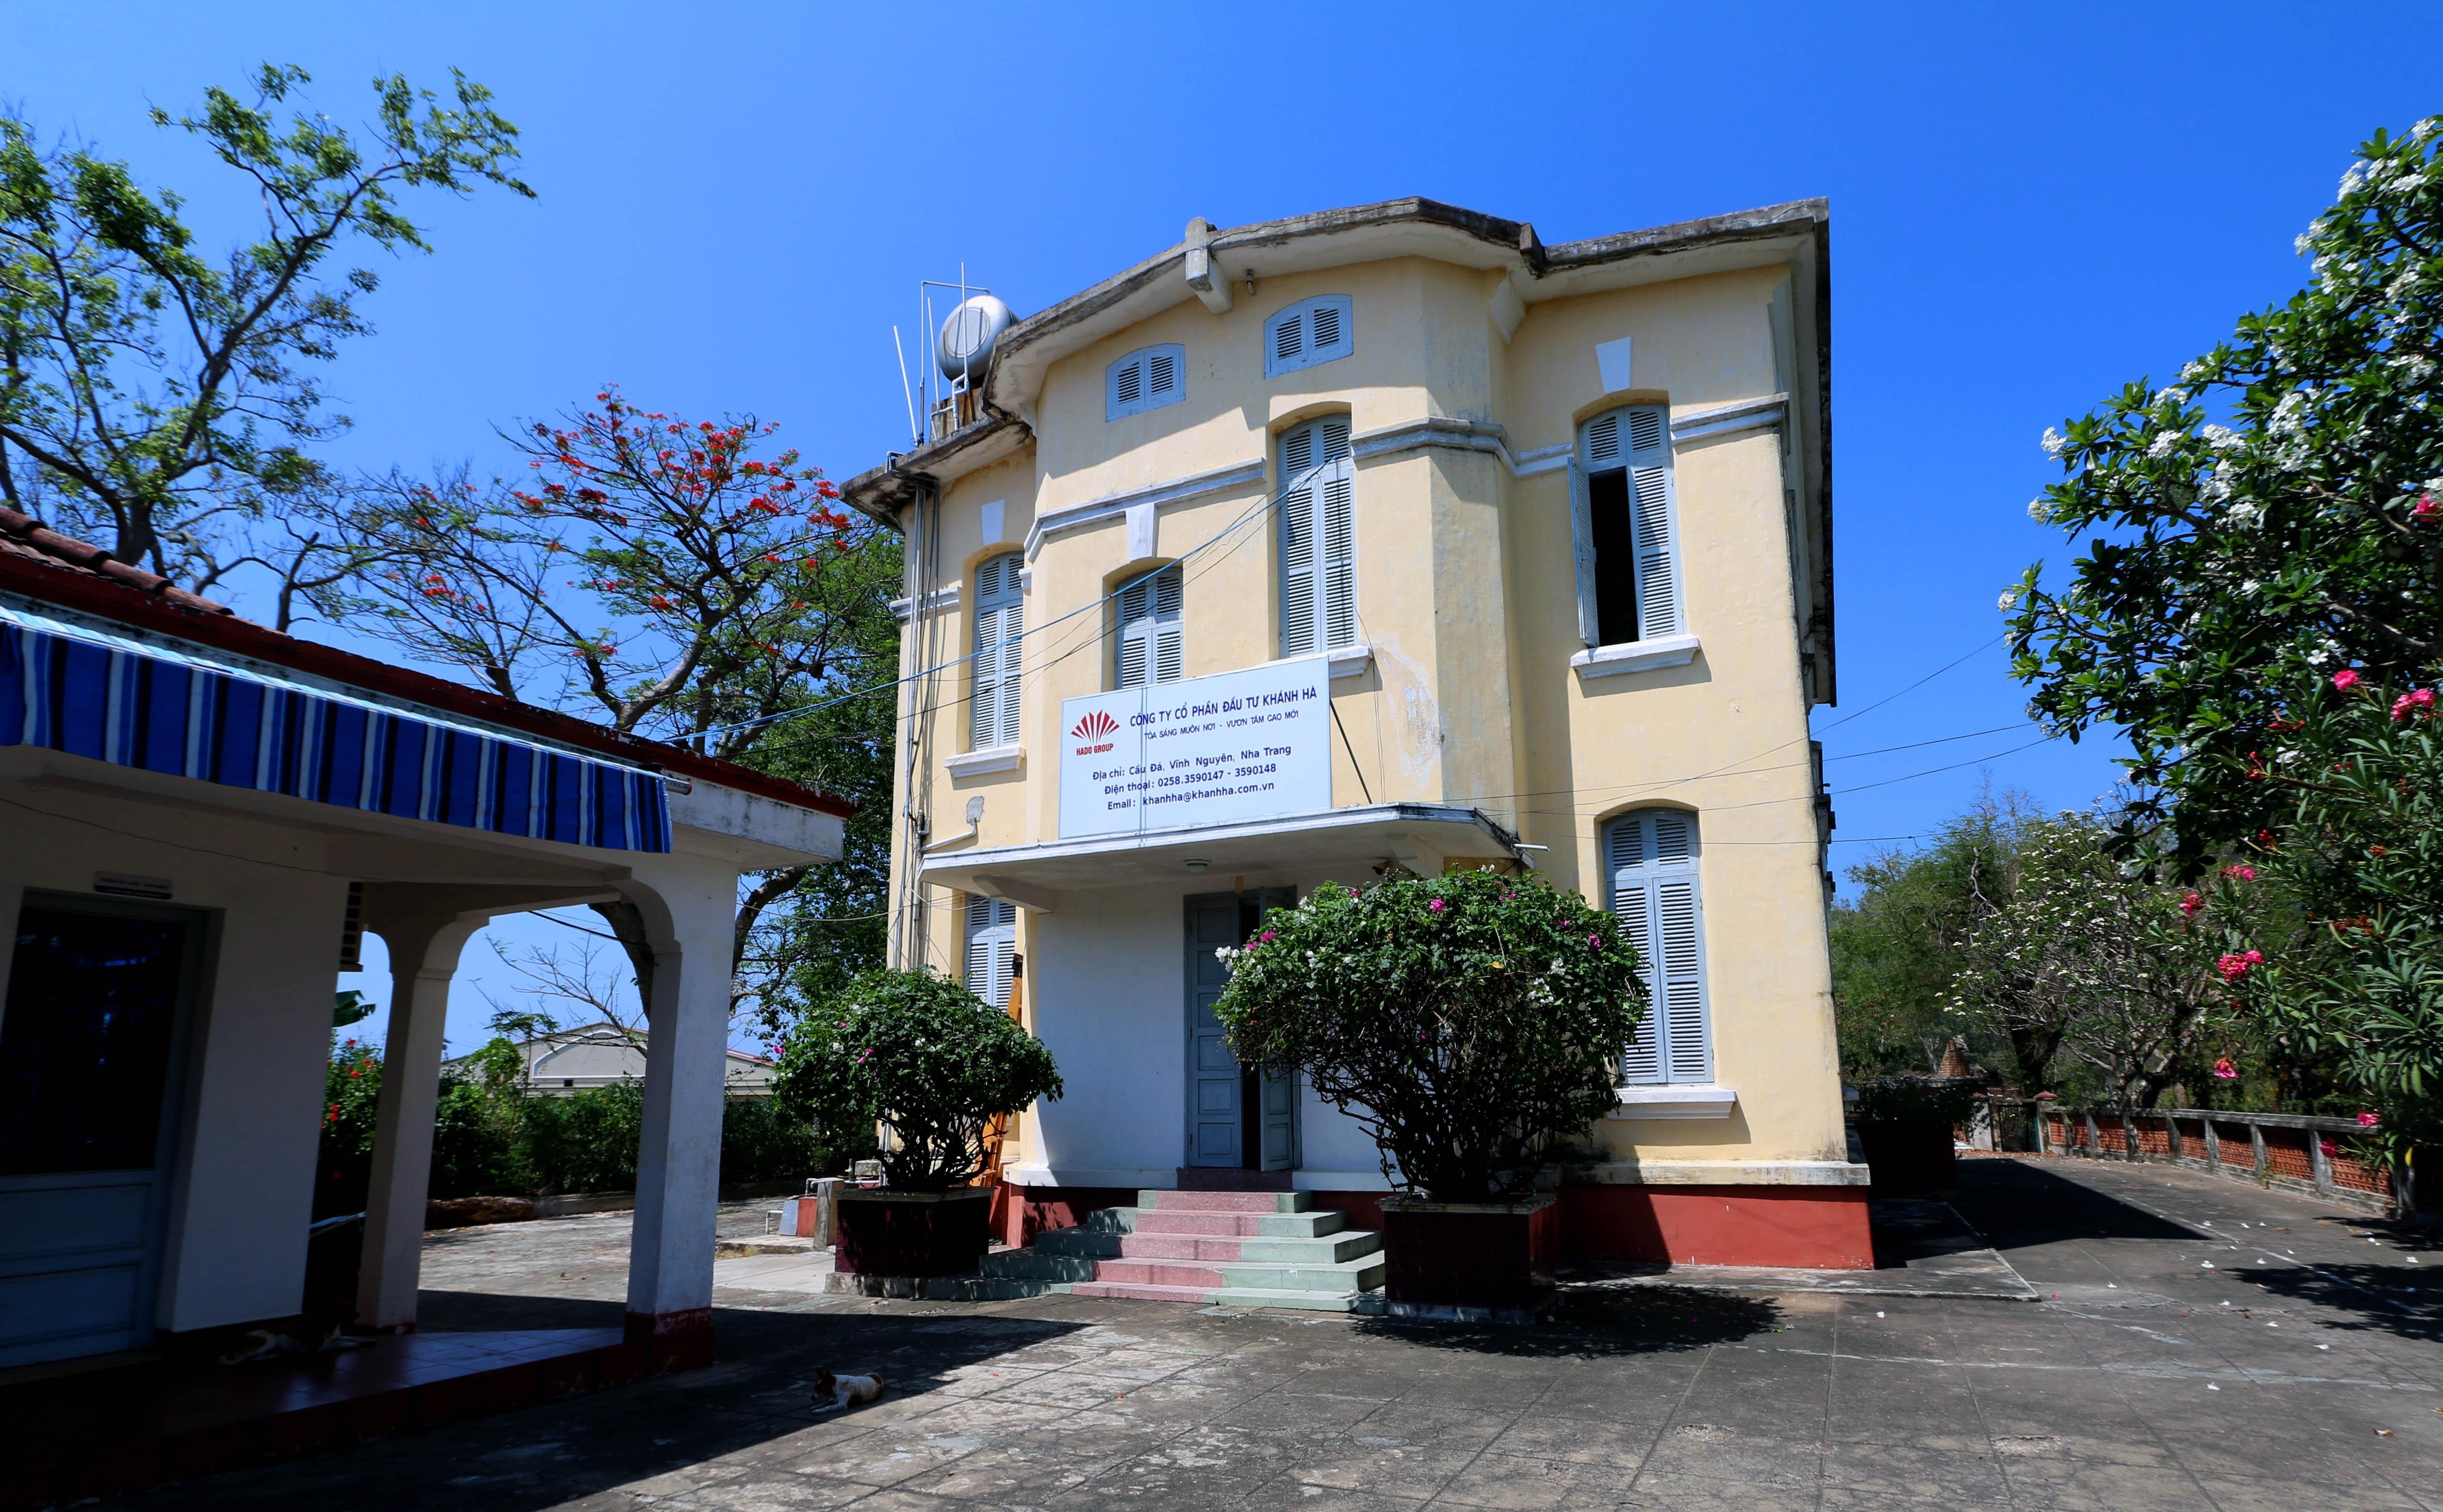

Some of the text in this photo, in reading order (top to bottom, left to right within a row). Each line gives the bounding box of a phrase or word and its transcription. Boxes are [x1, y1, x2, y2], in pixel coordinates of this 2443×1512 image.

[1130, 712, 1156, 726] CÔNG
[1159, 709, 1172, 722] TY
[1175, 702, 1188, 719] CỔ
[1246, 695, 1260, 709] TƯ
[1263, 690, 1299, 707] KHÁNH
[1302, 685, 1317, 700] HÀ
[1159, 728, 1177, 738] SÁNG
[1180, 724, 1200, 735] MUÔN
[1267, 713, 1282, 722] CAO
[1076, 743, 1114, 756] HADO GROUP
[1093, 771, 1107, 782] Địa
[1150, 762, 1165, 772] Đá,
[1169, 759, 1190, 769] Vĩnh
[1195, 753, 1235, 767] Nguyên,
[1241, 750, 1260, 760] Nha
[1263, 746, 1291, 756] Trang
[1105, 784, 1124, 795] Điện
[1158, 770, 1224, 787] 0258.3590147
[1235, 763, 1276, 777] 3590148
[1142, 782, 1274, 805] khanhha@khanhha.com.vn
